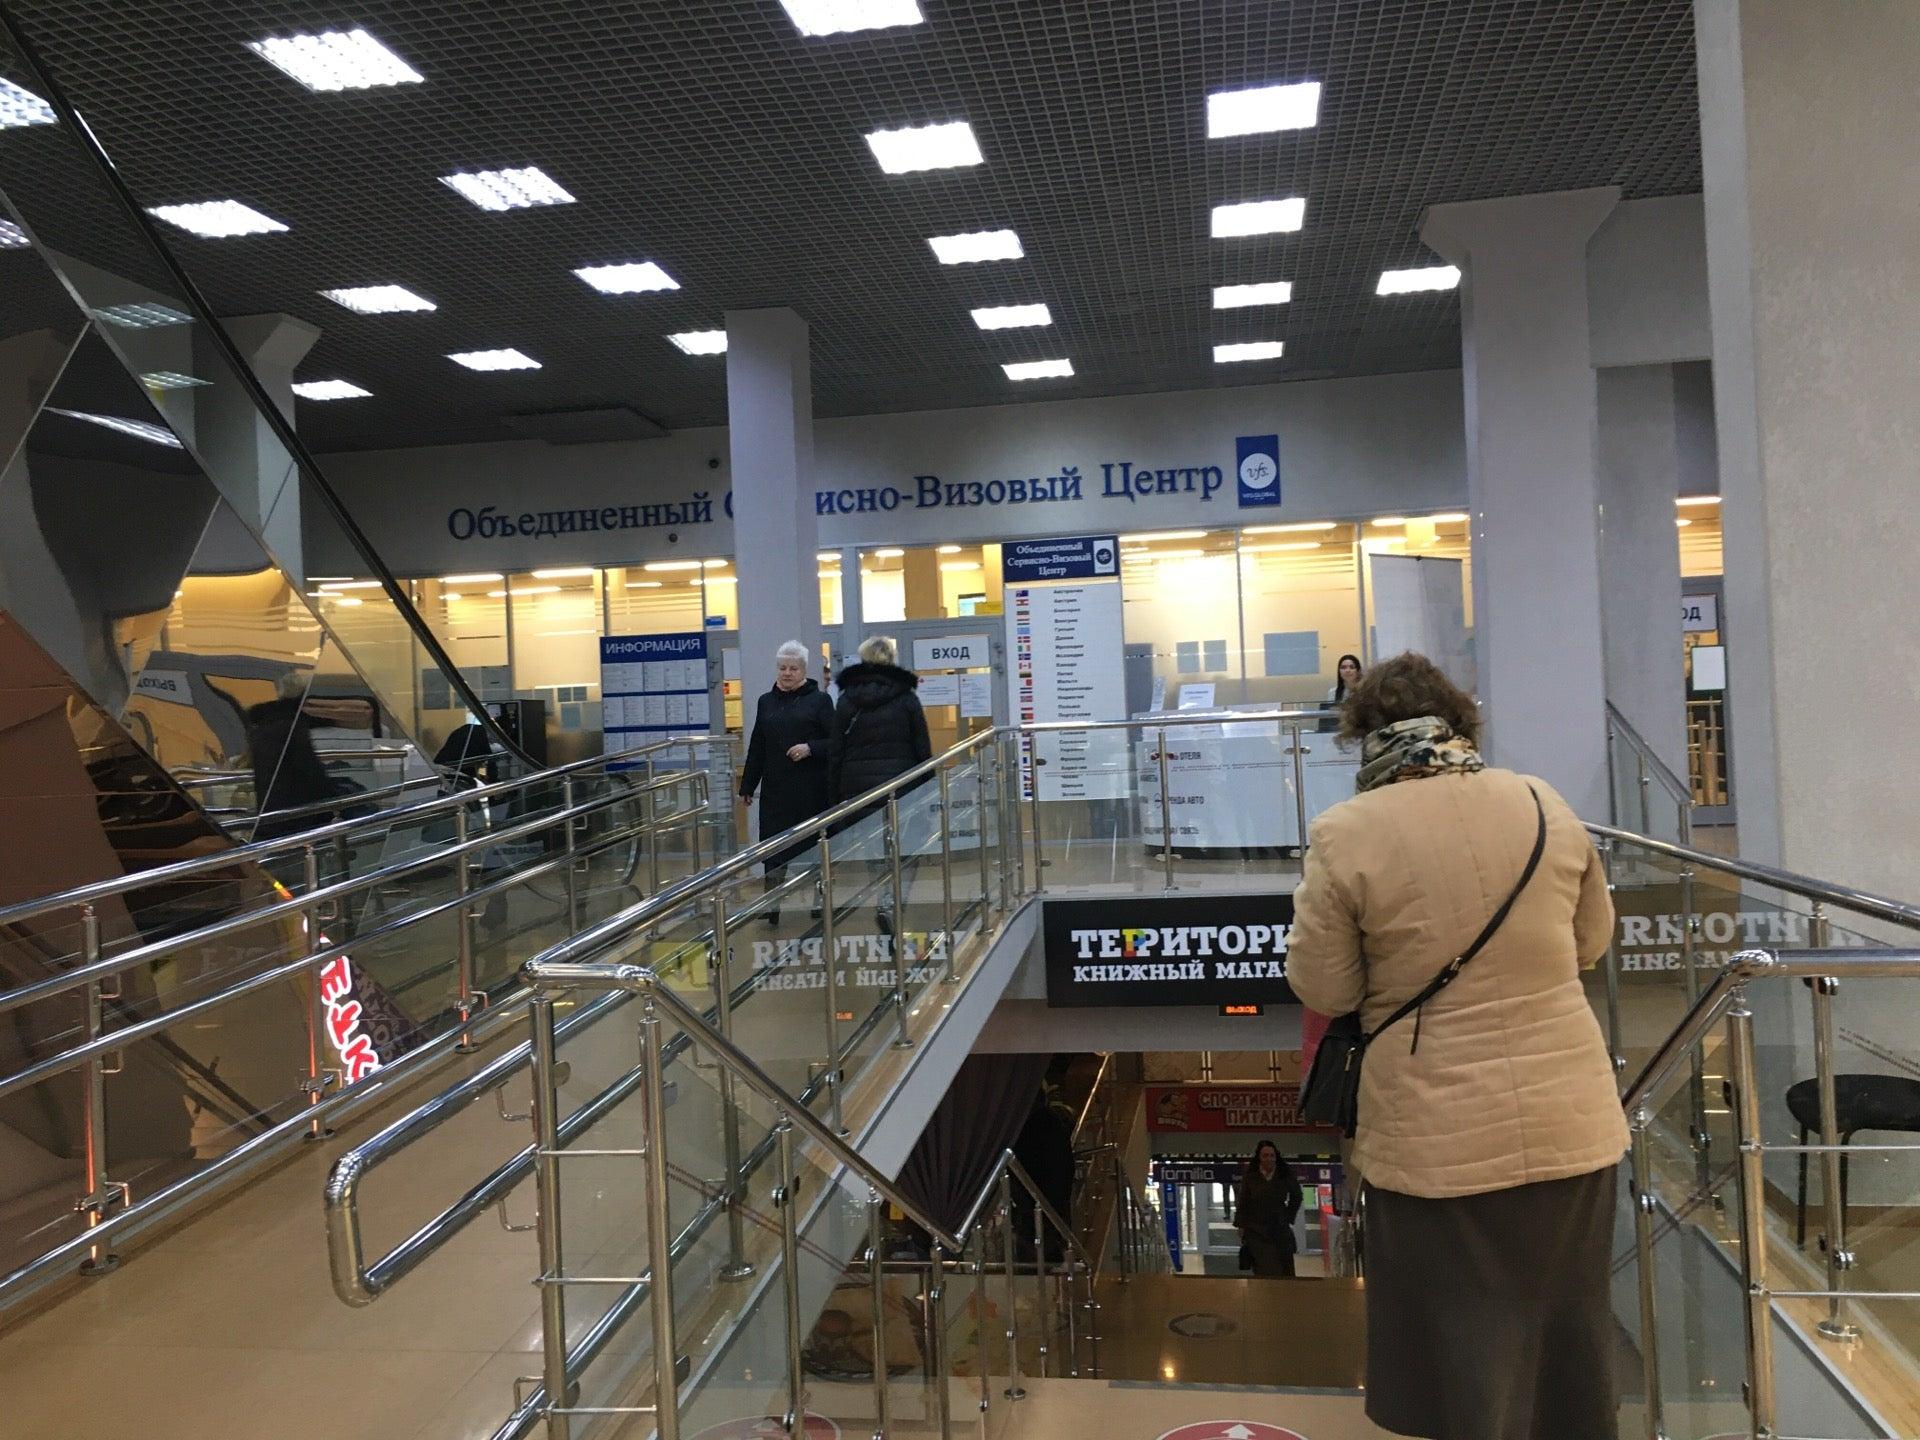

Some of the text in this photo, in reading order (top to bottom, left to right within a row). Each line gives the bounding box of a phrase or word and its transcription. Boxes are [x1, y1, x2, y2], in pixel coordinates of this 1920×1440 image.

[448, 461, 1223, 541] Объединенный исно-Визовый Центр
[1016, 542, 1083, 554] Объединенный
[1038, 567, 1067, 576] Центр
[606, 638, 701, 654] ИНФОРМАЦИЯ
[932, 646, 970, 660] ВХОД
[1071, 924, 1293, 958] ТЕРРИТОРИ
[1073, 959, 1288, 982] КНИЖНЫЙ МАГА
[1200, 1092, 1299, 1107] СПОРТИВНОЕ
[1227, 1108, 1305, 1125] ПИТАНИЕ
